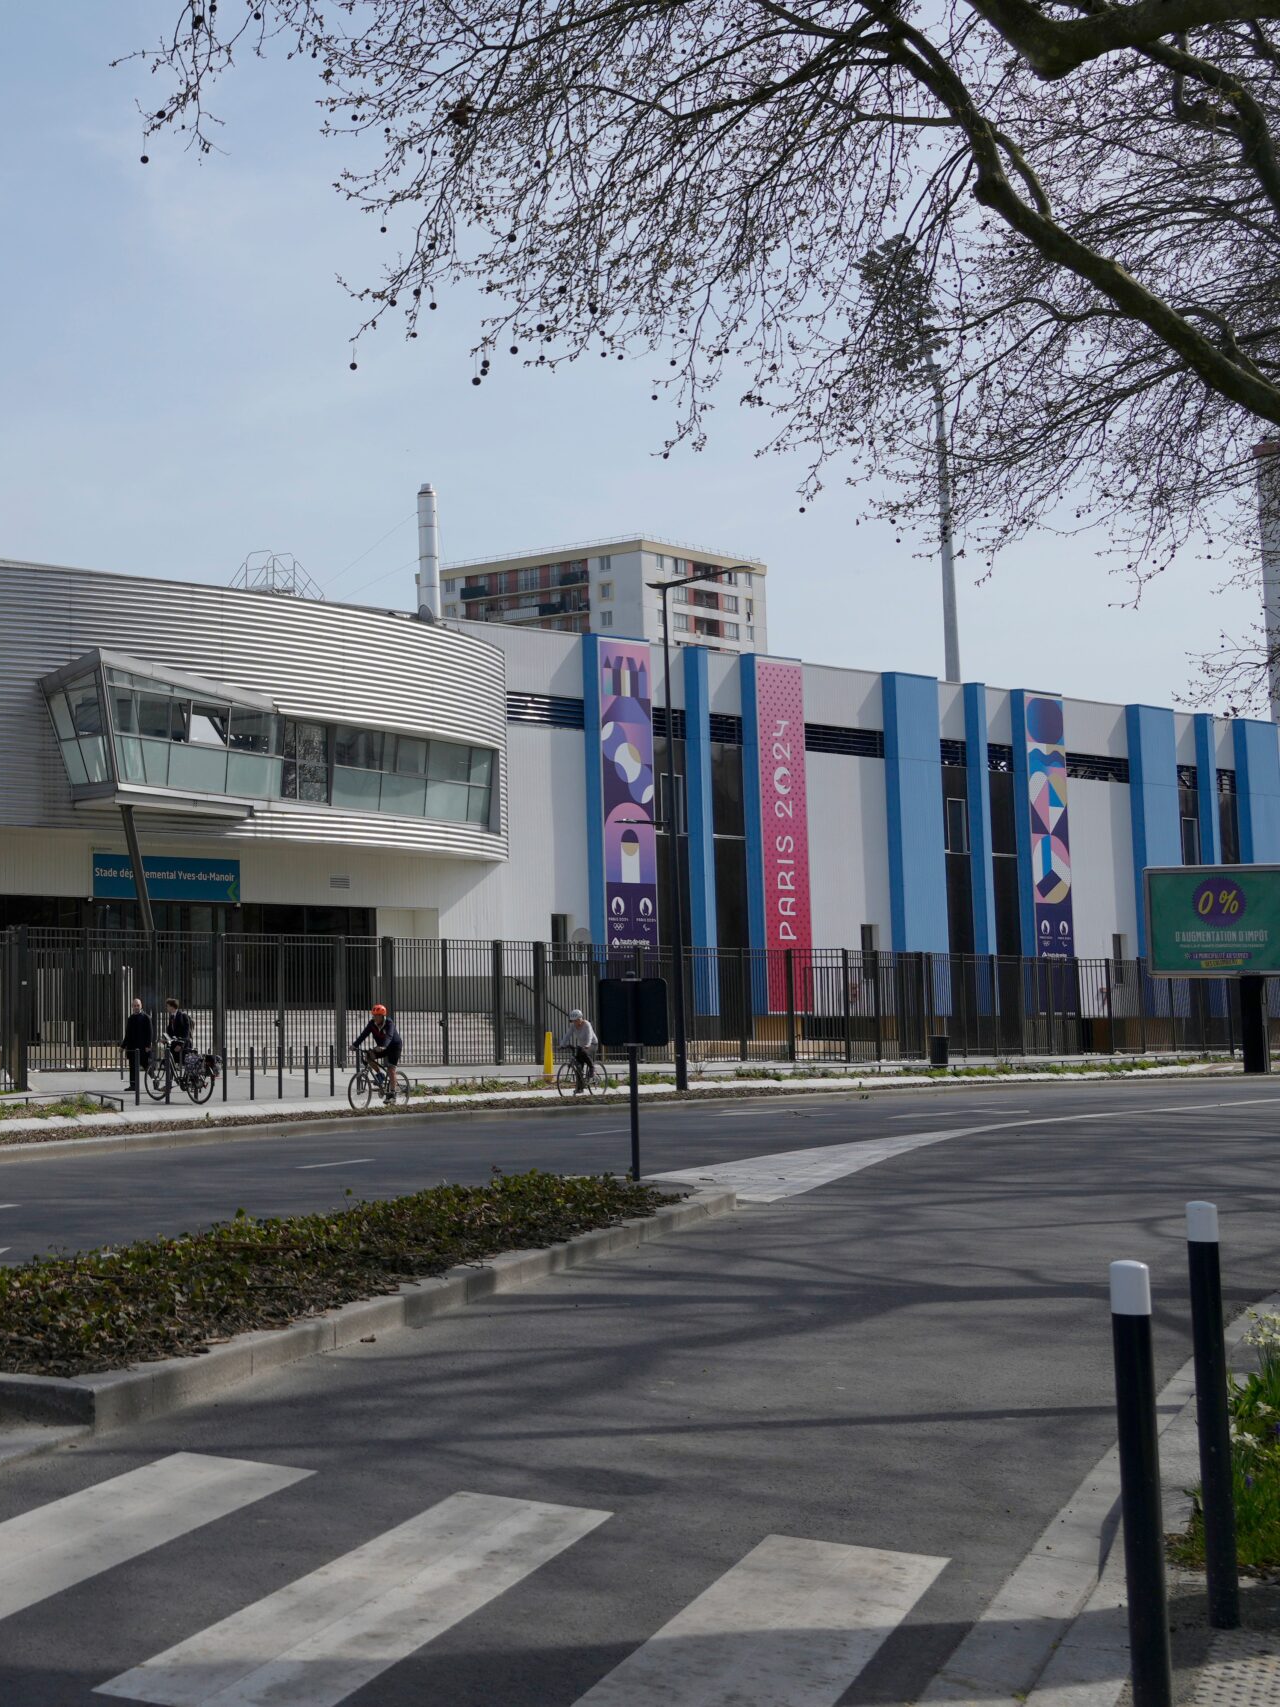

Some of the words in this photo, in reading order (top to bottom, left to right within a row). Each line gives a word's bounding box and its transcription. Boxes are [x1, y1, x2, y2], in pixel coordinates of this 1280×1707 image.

[772, 720, 793, 819] 2024
[95, 867, 118, 878] Stade
[119, 868, 177, 880] dépemental
[177, 870, 236, 882] Yves-du-Manoir
[775, 835, 797, 941] PARIS
[1198, 890, 1214, 915] 0
[1175, 930, 1237, 942] D'AUGMENTATION
[1238, 929, 1269, 942] D'IMPÔT
